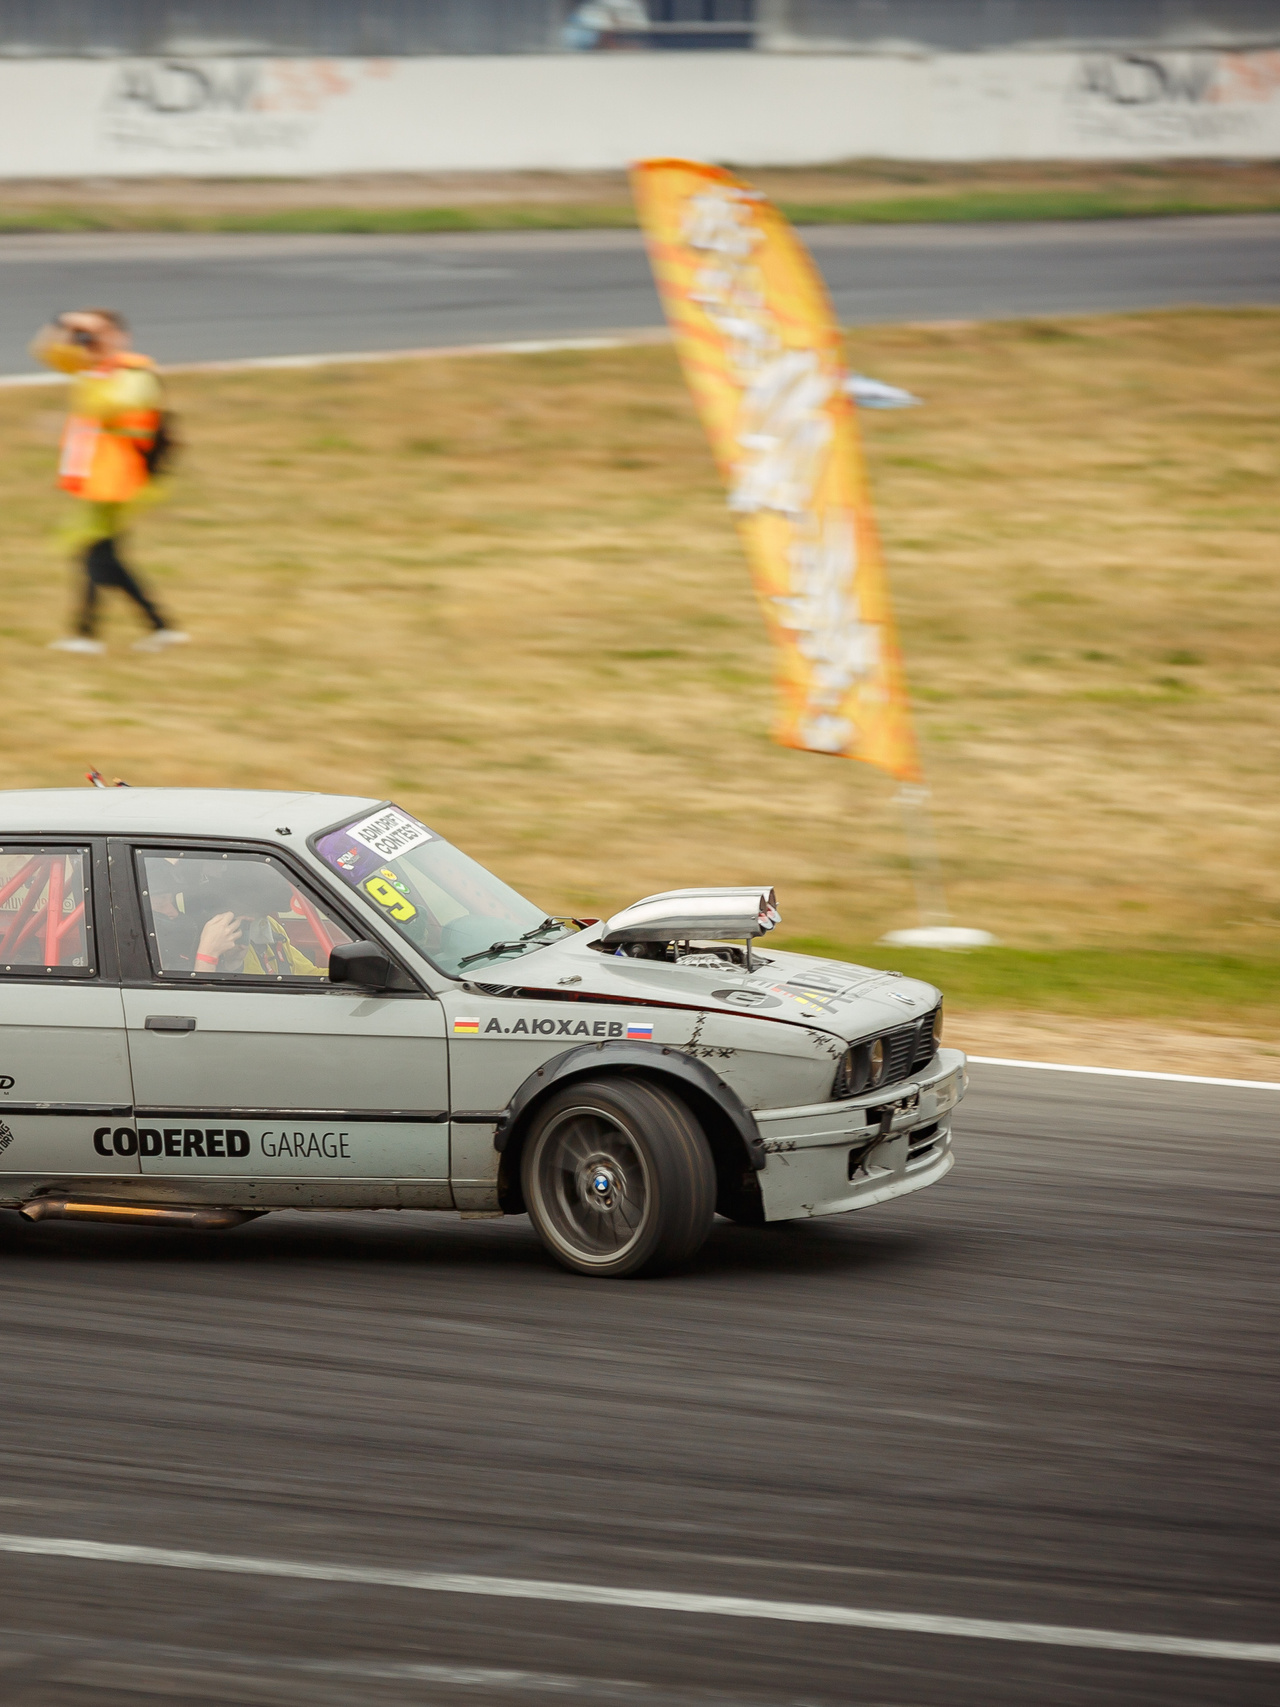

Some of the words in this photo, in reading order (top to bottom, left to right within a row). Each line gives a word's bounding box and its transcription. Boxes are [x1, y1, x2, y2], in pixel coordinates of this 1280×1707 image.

[359, 823, 386, 844] ADM
[373, 812, 404, 831] DRIFT
[374, 823, 423, 855] CONTEST
[363, 875, 418, 925] 9
[484, 1017, 624, 1037] А.АЮХАЕВ
[93, 1127, 251, 1158] CODERED
[260, 1131, 352, 1159] GARAGE
